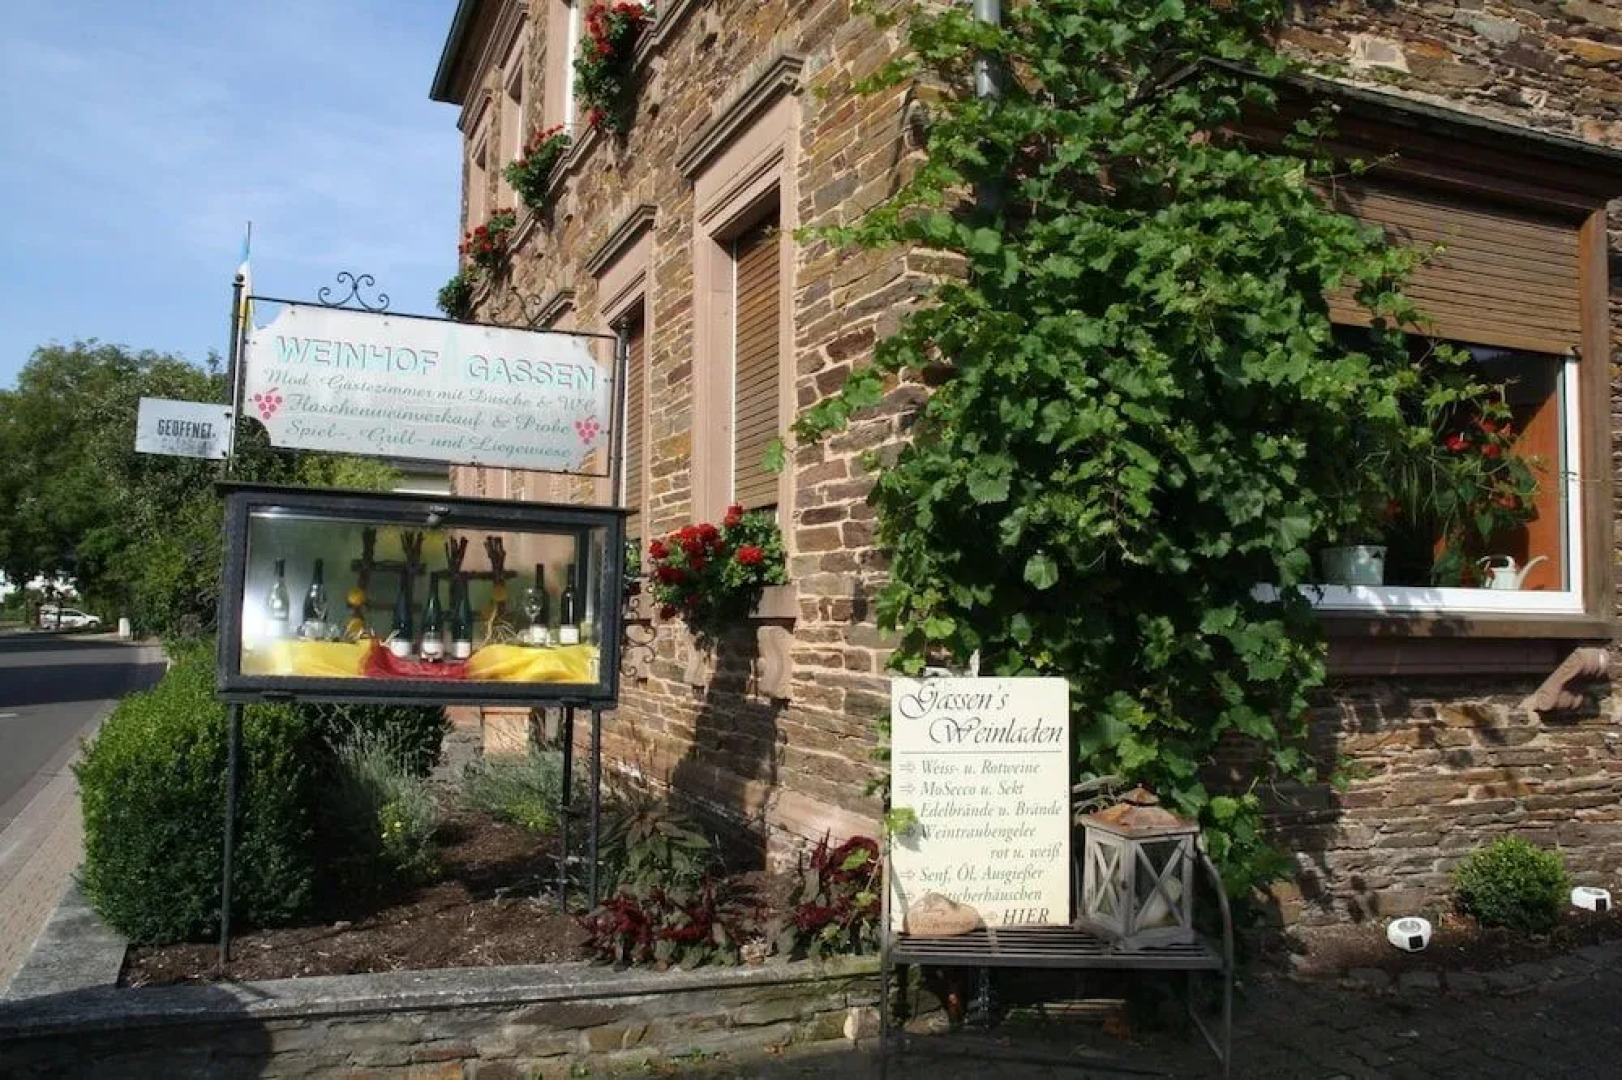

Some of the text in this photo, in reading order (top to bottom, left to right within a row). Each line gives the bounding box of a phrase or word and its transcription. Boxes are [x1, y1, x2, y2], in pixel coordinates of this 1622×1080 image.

[275, 335, 596, 391] WEINHOF GASSEN
[437, 388, 464, 401] mit
[469, 386, 531, 407] Dusche
[285, 393, 571, 435] Flaschenweinverkauf & Probe
[430, 433, 465, 450] und
[468, 436, 571, 460] Liegewiese
[929, 716, 1064, 745] Weinladen
[921, 757, 1041, 776] Weiss- u. Rotweine
[920, 779, 1025, 797] MoSecco u. Sekt
[920, 799, 1063, 818] Edelbrände u. Brände
[922, 822, 1037, 842] Weintraubengelee
[989, 841, 1064, 862] rot u. weiß
[982, 863, 1045, 885] Ausgießer
[1002, 906, 1051, 926] HIER
